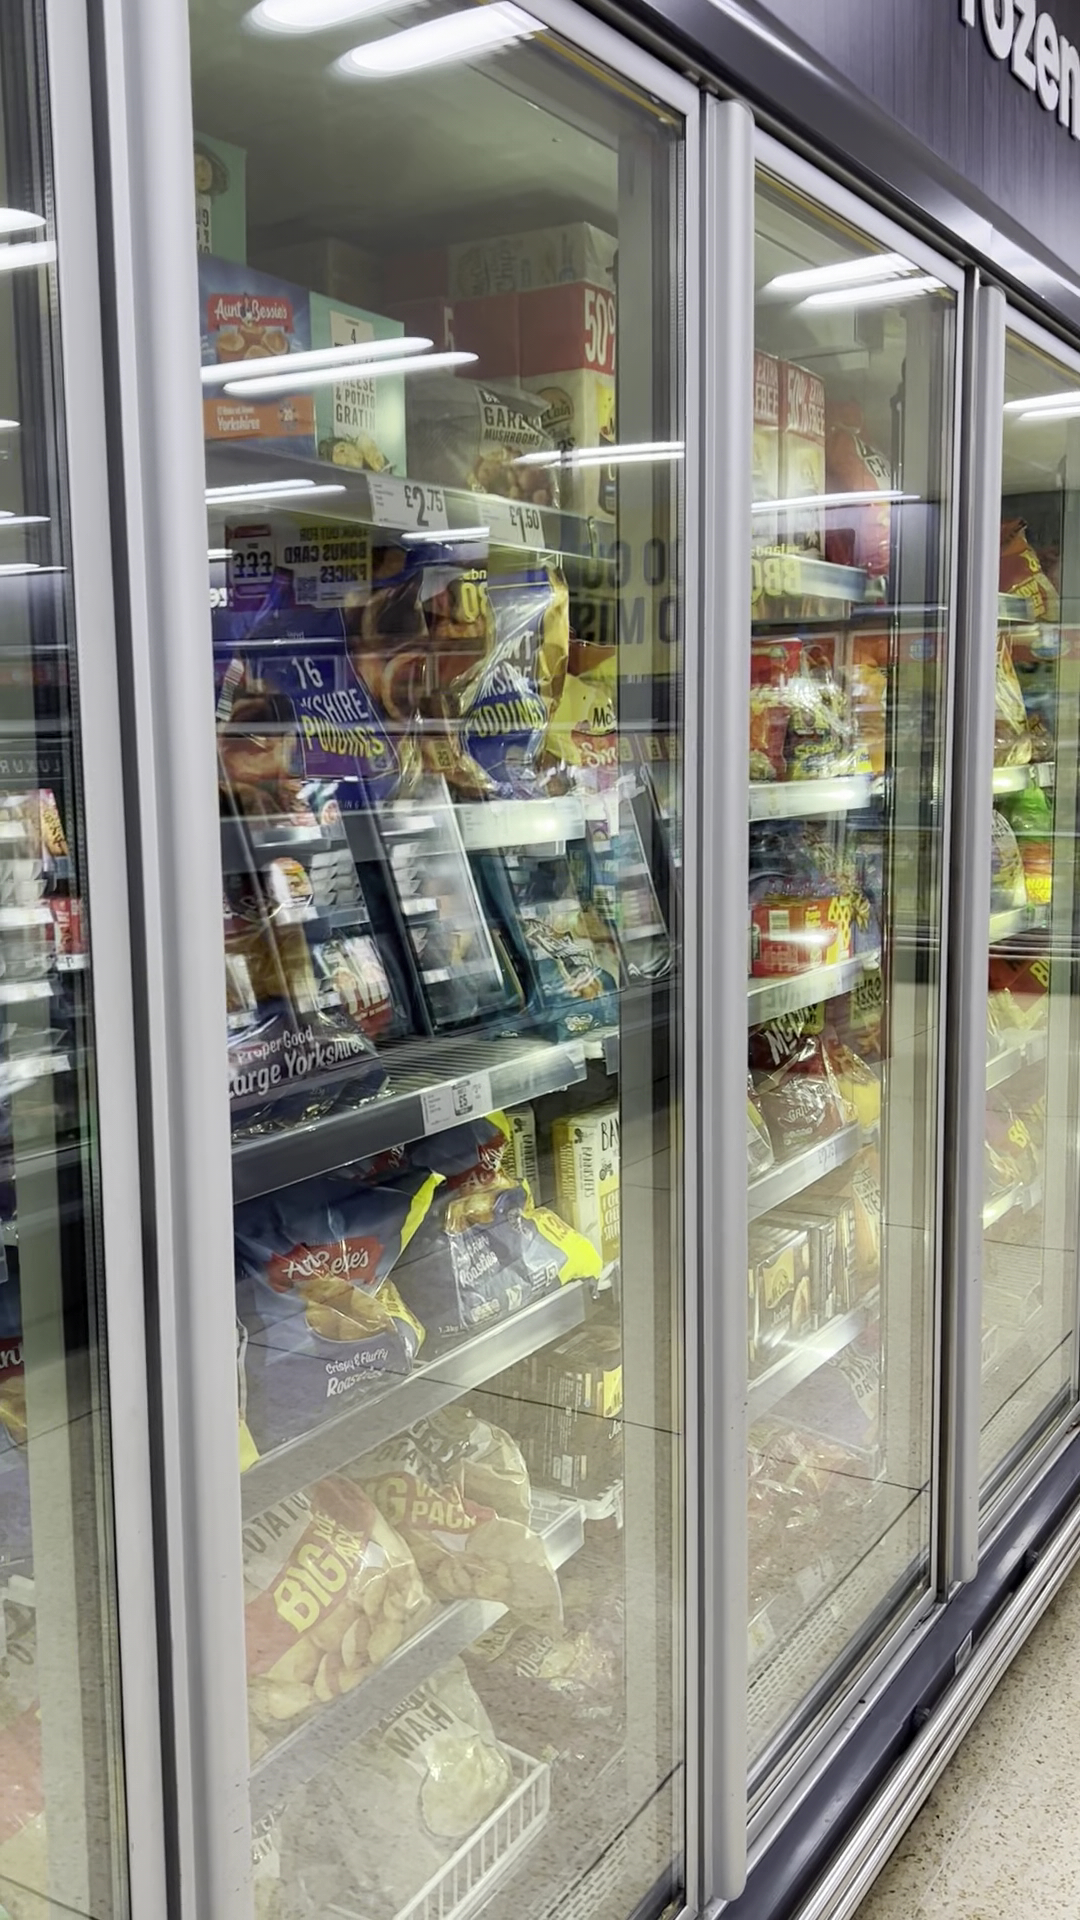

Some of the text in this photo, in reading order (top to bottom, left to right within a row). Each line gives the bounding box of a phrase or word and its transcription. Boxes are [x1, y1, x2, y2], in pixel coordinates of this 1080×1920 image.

[214, 297, 243, 322] Aunt
[345, 388, 376, 409] POTATO
[335, 402, 376, 430] GRATIN
[483, 428, 541, 448] MUSHROOMS
[404, 484, 445, 527] £2.75
[508, 504, 542, 543] £1.50
[291, 656, 324, 690] 16
[282, 1024, 315, 1049] Good
[325, 1360, 356, 1376] Crispy
[360, 1347, 389, 1365] Fluffy
[273, 1542, 348, 1633] BIG
[384, 1701, 455, 1758] MASH
